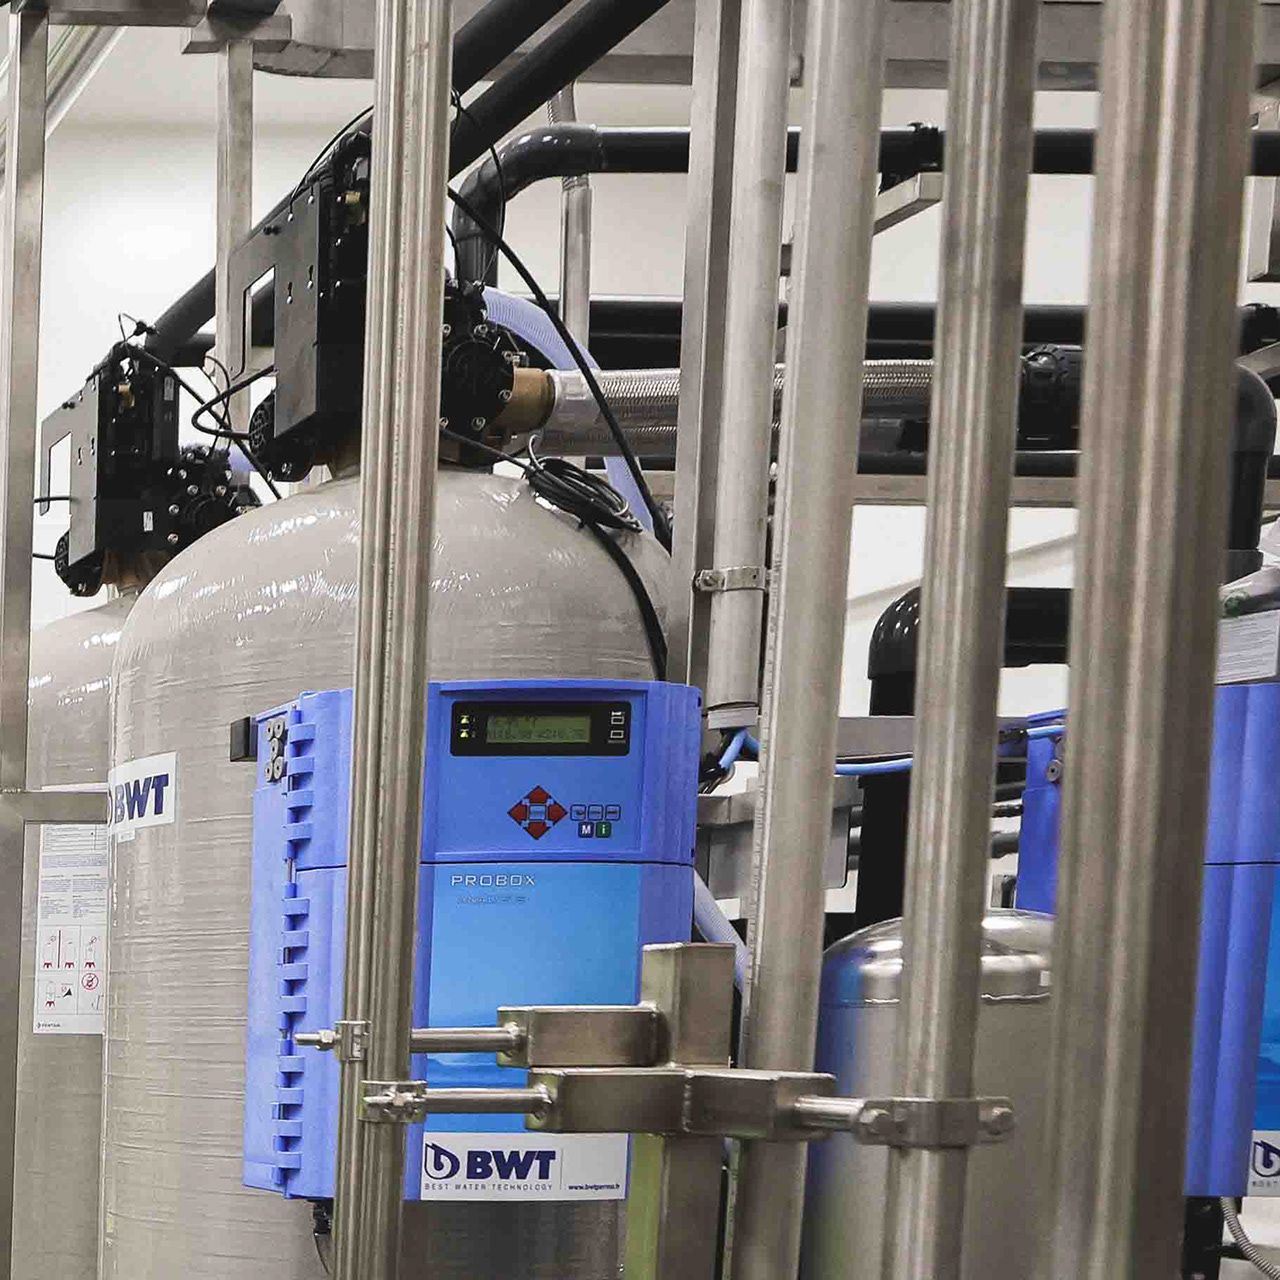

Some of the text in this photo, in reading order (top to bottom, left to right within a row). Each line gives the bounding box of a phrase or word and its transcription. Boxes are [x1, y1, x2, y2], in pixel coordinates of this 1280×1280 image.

[115, 773, 169, 824] BWT
[451, 875, 535, 886] PROBOX
[466, 1150, 556, 1180] BWT
